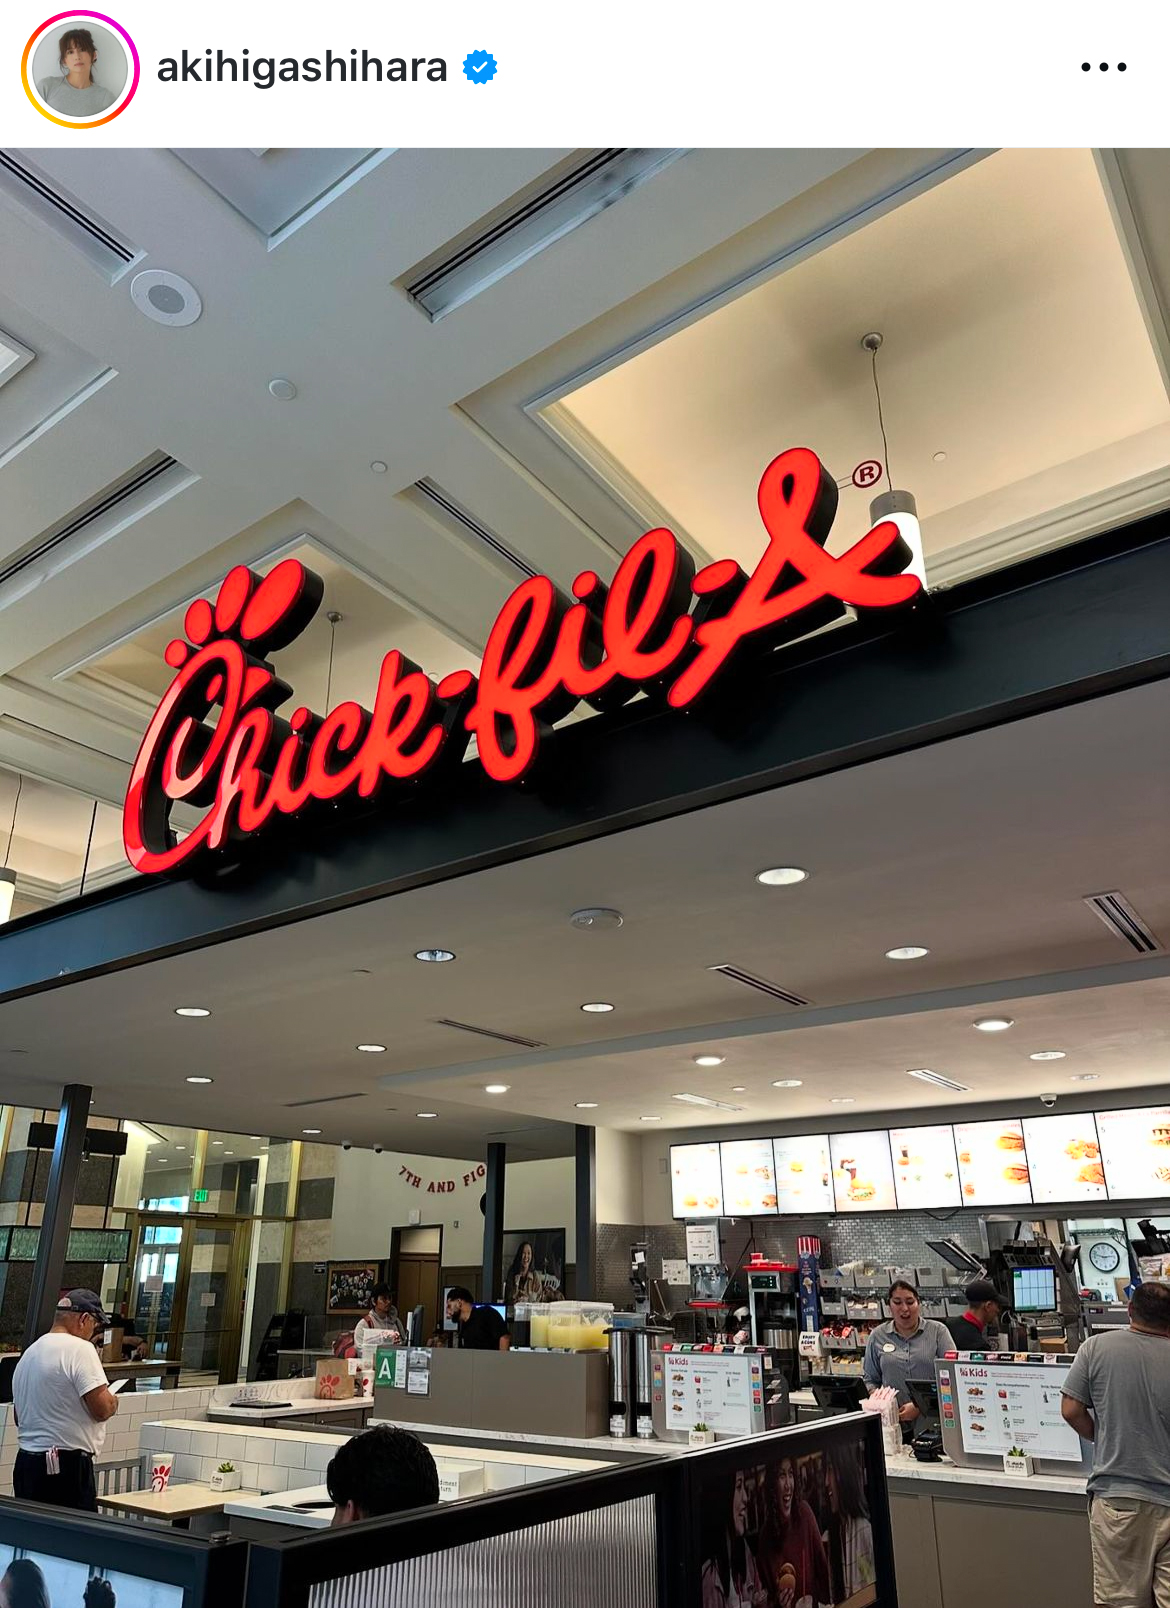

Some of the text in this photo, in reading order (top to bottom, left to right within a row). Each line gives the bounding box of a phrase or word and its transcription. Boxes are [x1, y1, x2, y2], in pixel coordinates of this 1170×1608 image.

[399, 1164, 486, 1193] 7TH AND FIG
[378, 1357, 392, 1379] A
[675, 1357, 689, 1366] Kids
[969, 1368, 988, 1377] Kids
